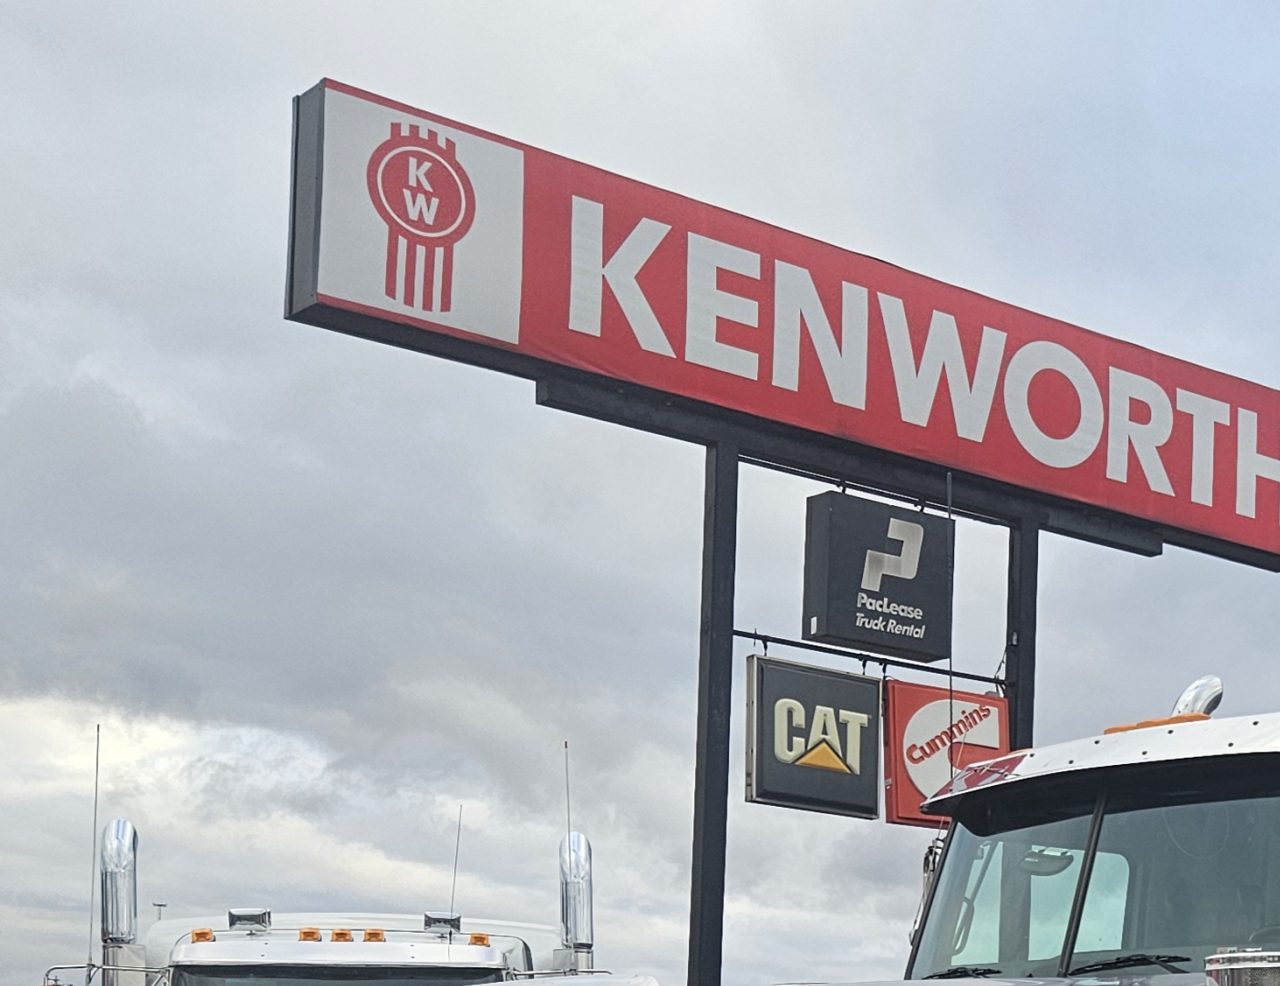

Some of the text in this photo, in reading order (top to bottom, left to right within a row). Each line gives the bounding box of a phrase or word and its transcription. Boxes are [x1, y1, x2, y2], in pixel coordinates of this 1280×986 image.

[855, 612, 926, 639] Truck Rental
[857, 592, 923, 620] PacLease
[774, 698, 869, 775] CAT
[905, 704, 992, 765] Cummins
